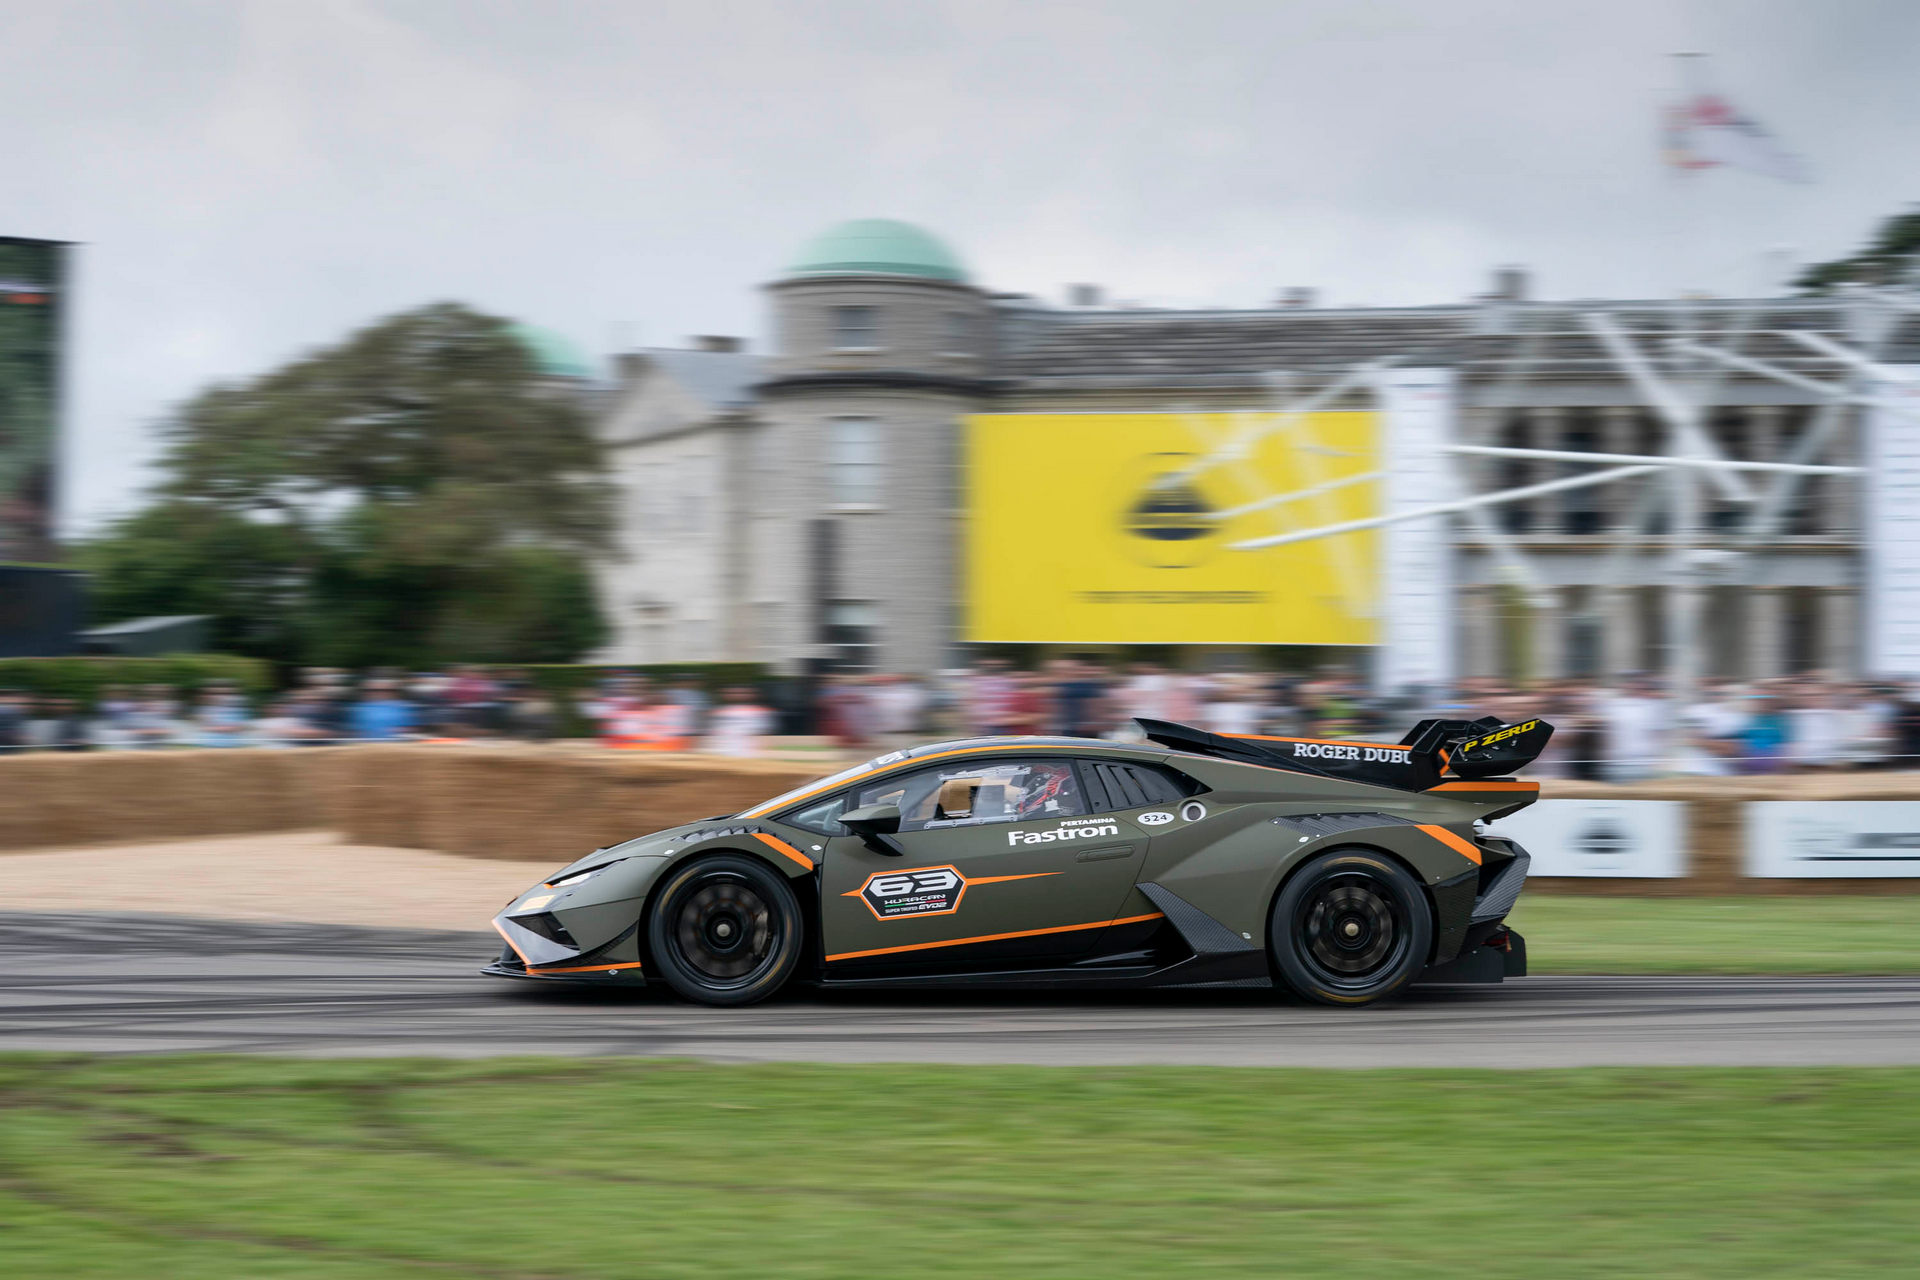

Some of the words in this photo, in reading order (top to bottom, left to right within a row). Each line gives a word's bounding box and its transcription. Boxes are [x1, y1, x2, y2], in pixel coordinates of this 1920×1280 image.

[1463, 740, 1478, 752] P
[1481, 720, 1538, 746] ZERO
[1293, 743, 1360, 761] ROGER
[1060, 817, 1116, 827] PERTAMINA
[1143, 814, 1168, 822] 524
[1008, 824, 1118, 846] Fastron
[869, 871, 958, 897] 63
